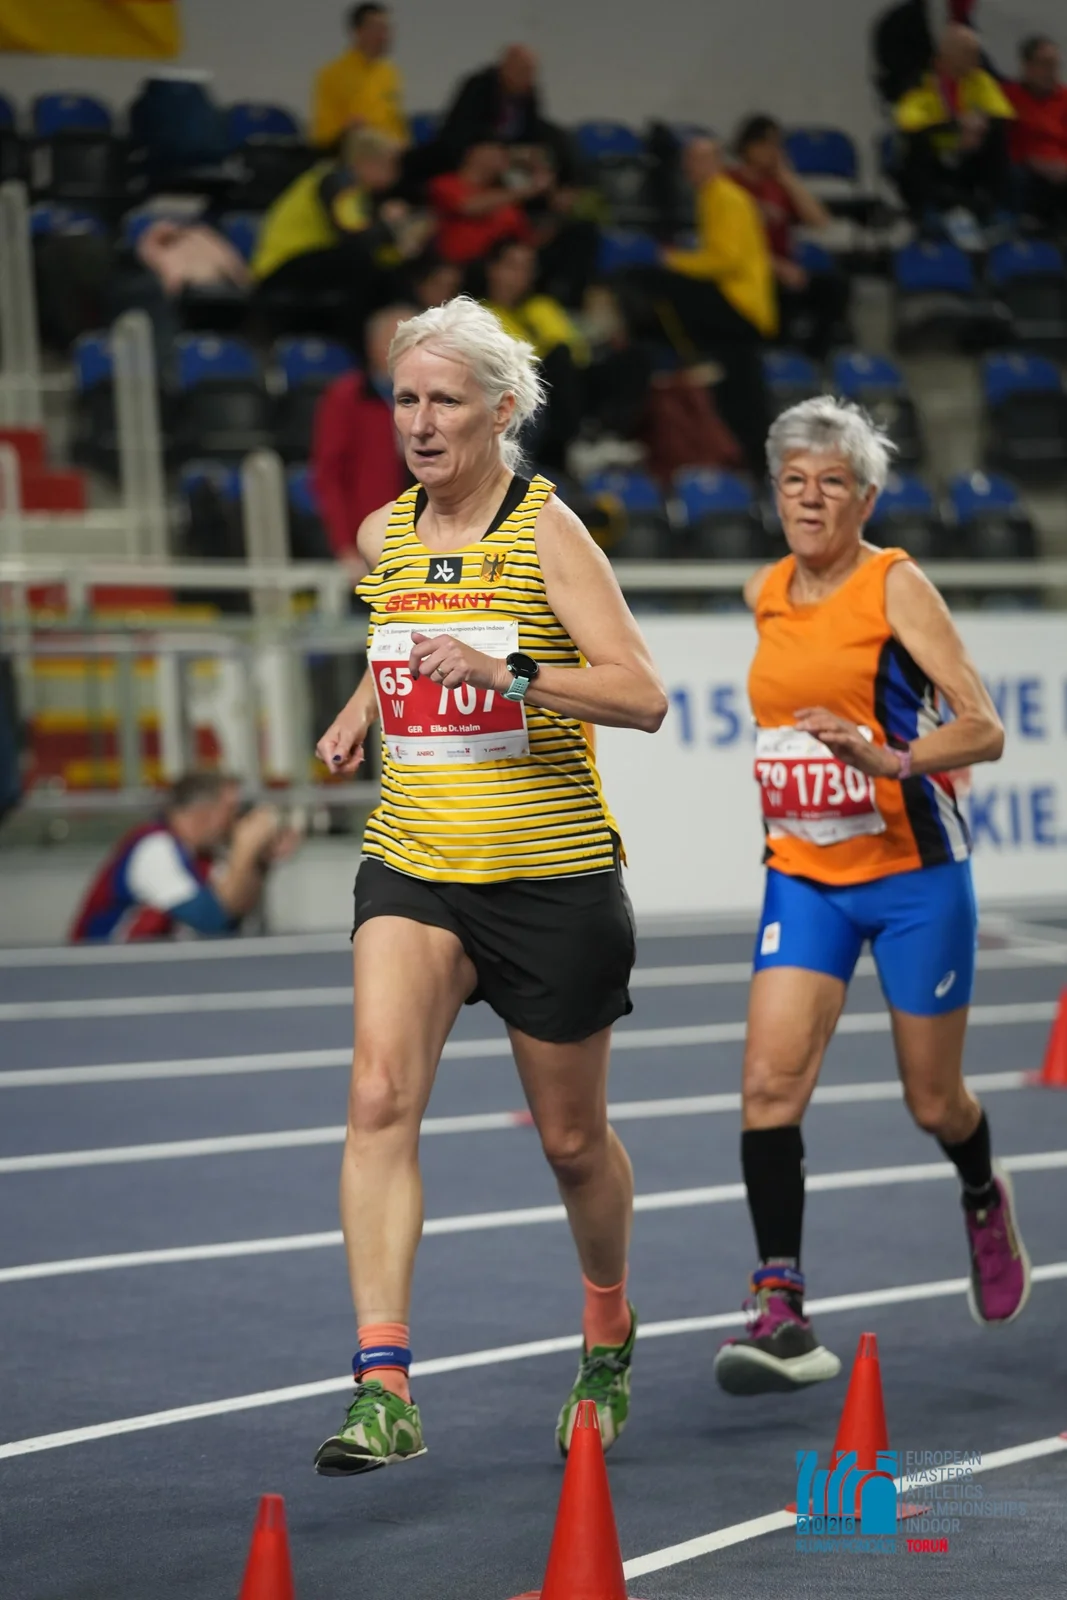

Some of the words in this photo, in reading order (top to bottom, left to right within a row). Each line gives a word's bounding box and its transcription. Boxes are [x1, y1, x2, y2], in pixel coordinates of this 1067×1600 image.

[385, 593, 496, 612] GERMANY
[447, 625, 486, 633] Championships
[379, 667, 413, 696] 65
[391, 700, 405, 719] W
[407, 725, 423, 734] GER
[430, 724, 447, 733] Elke
[448, 724, 459, 732] Dr.
[459, 723, 481, 732] Halm
[756, 762, 787, 789] 70
[792, 762, 868, 806] 1730
